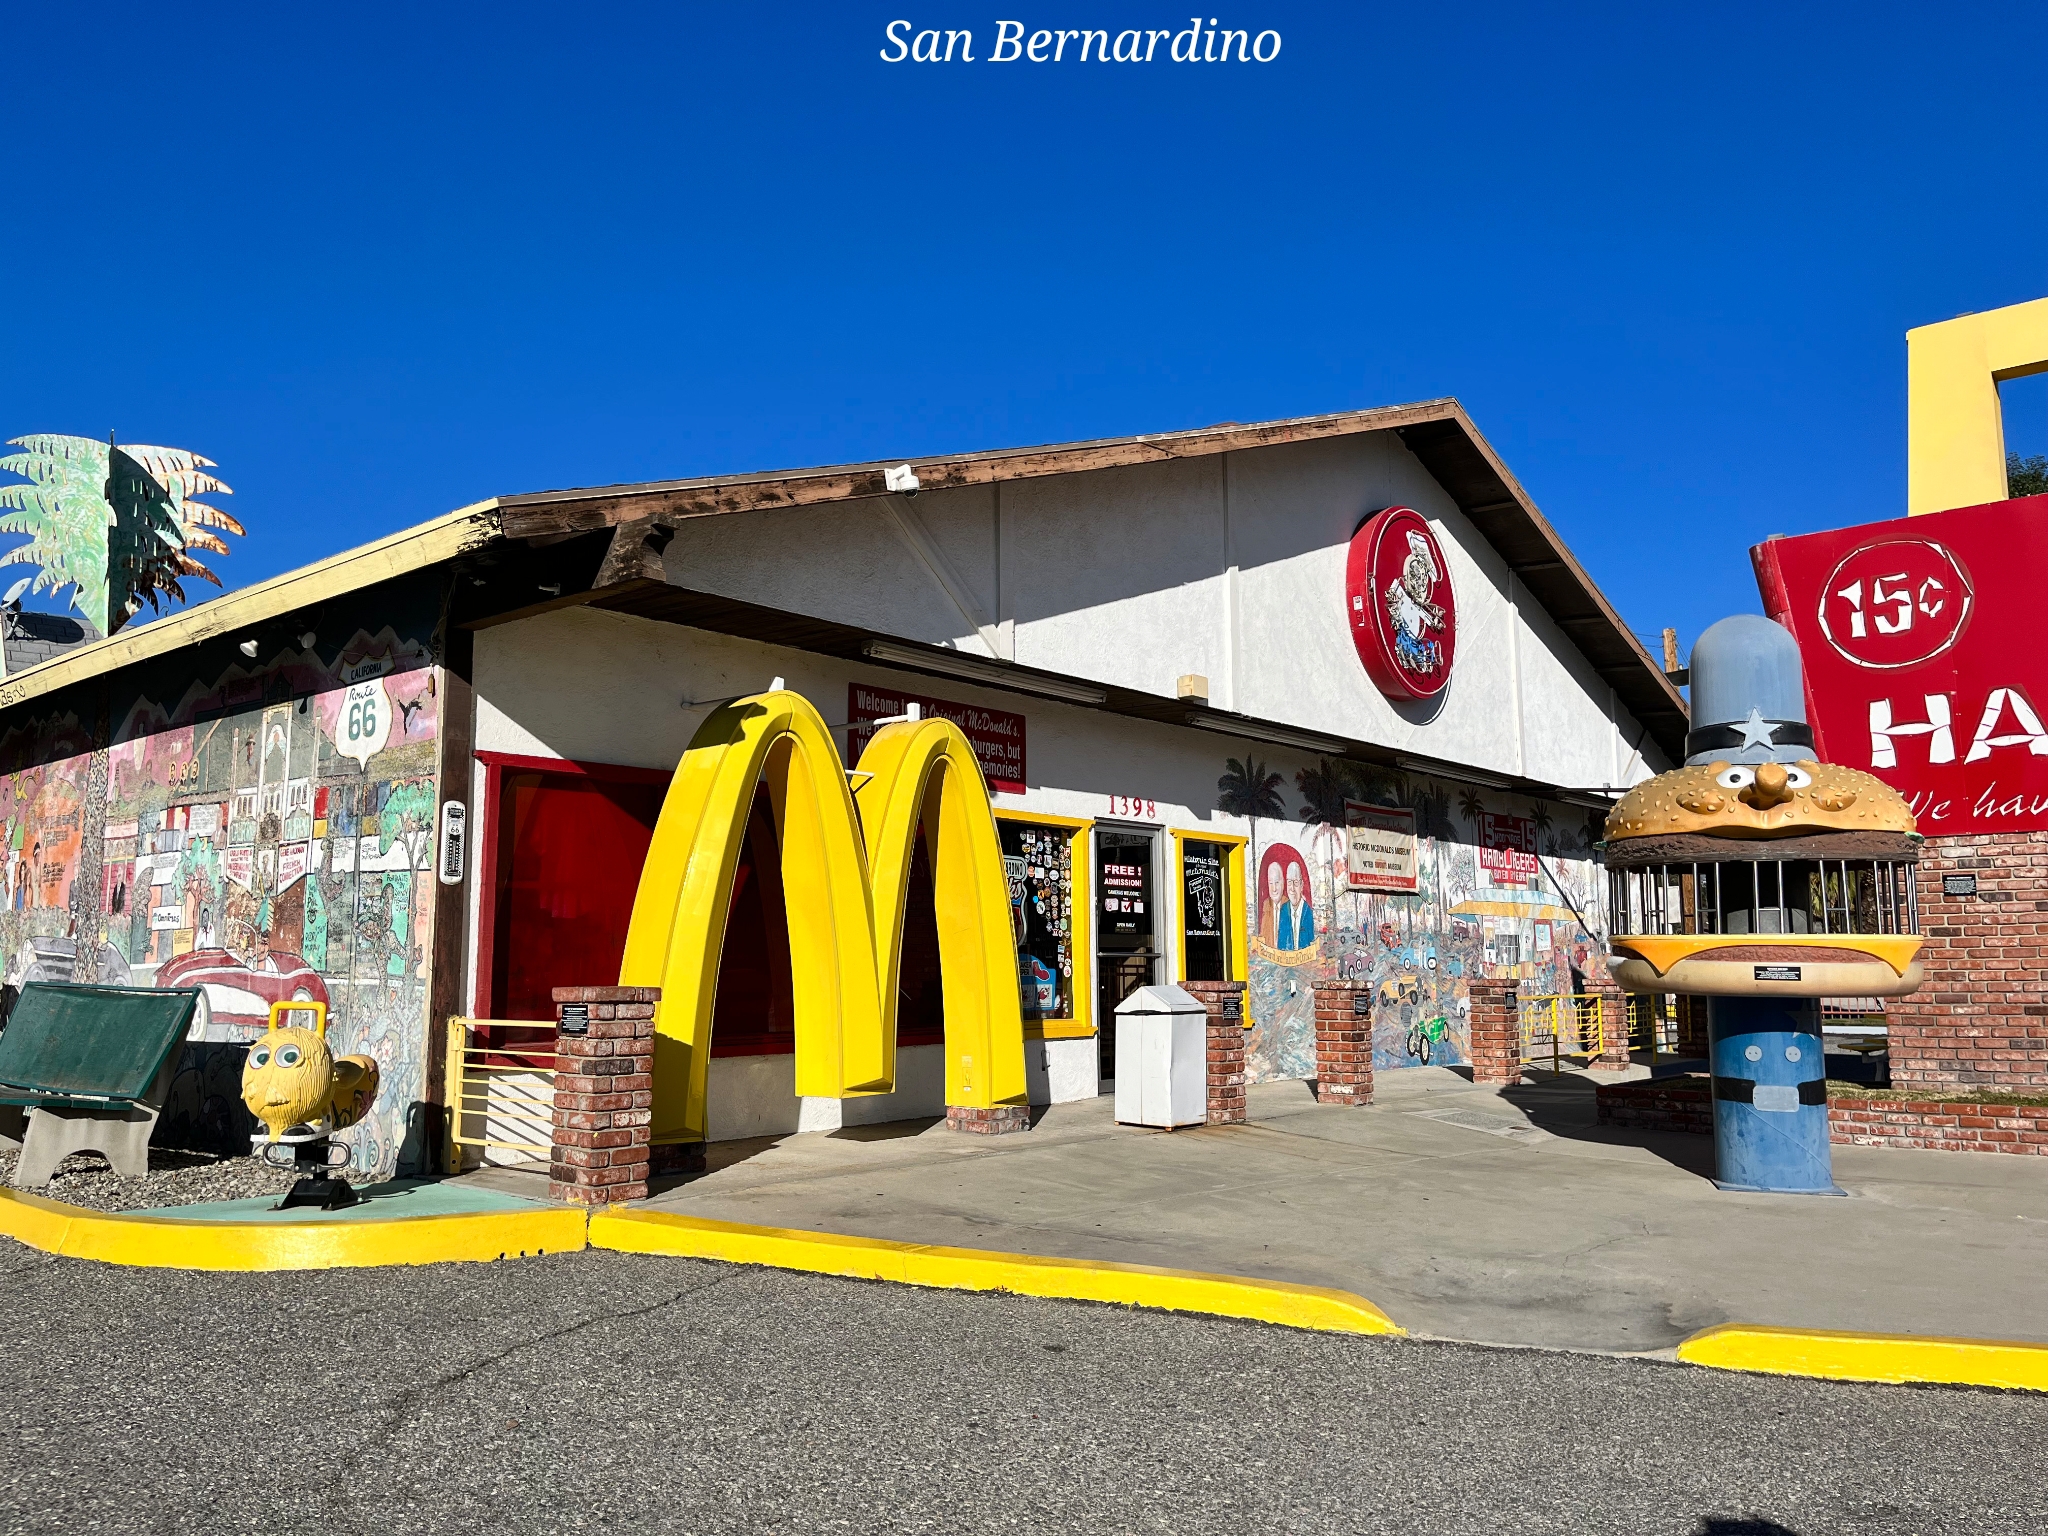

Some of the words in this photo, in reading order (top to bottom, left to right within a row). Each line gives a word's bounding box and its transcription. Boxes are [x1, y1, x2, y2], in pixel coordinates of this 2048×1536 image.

[350, 662, 382, 681] CALIFORNIA
[349, 685, 377, 702] Route
[857, 690, 899, 715] Welcome
[348, 698, 376, 741] 66
[1007, 742, 1021, 761] but
[1108, 794, 1156, 819] 1398
[282, 860, 301, 871] FRENCH
[1104, 864, 1135, 876] FREE
[1103, 877, 1142, 888] ADMISSION!
